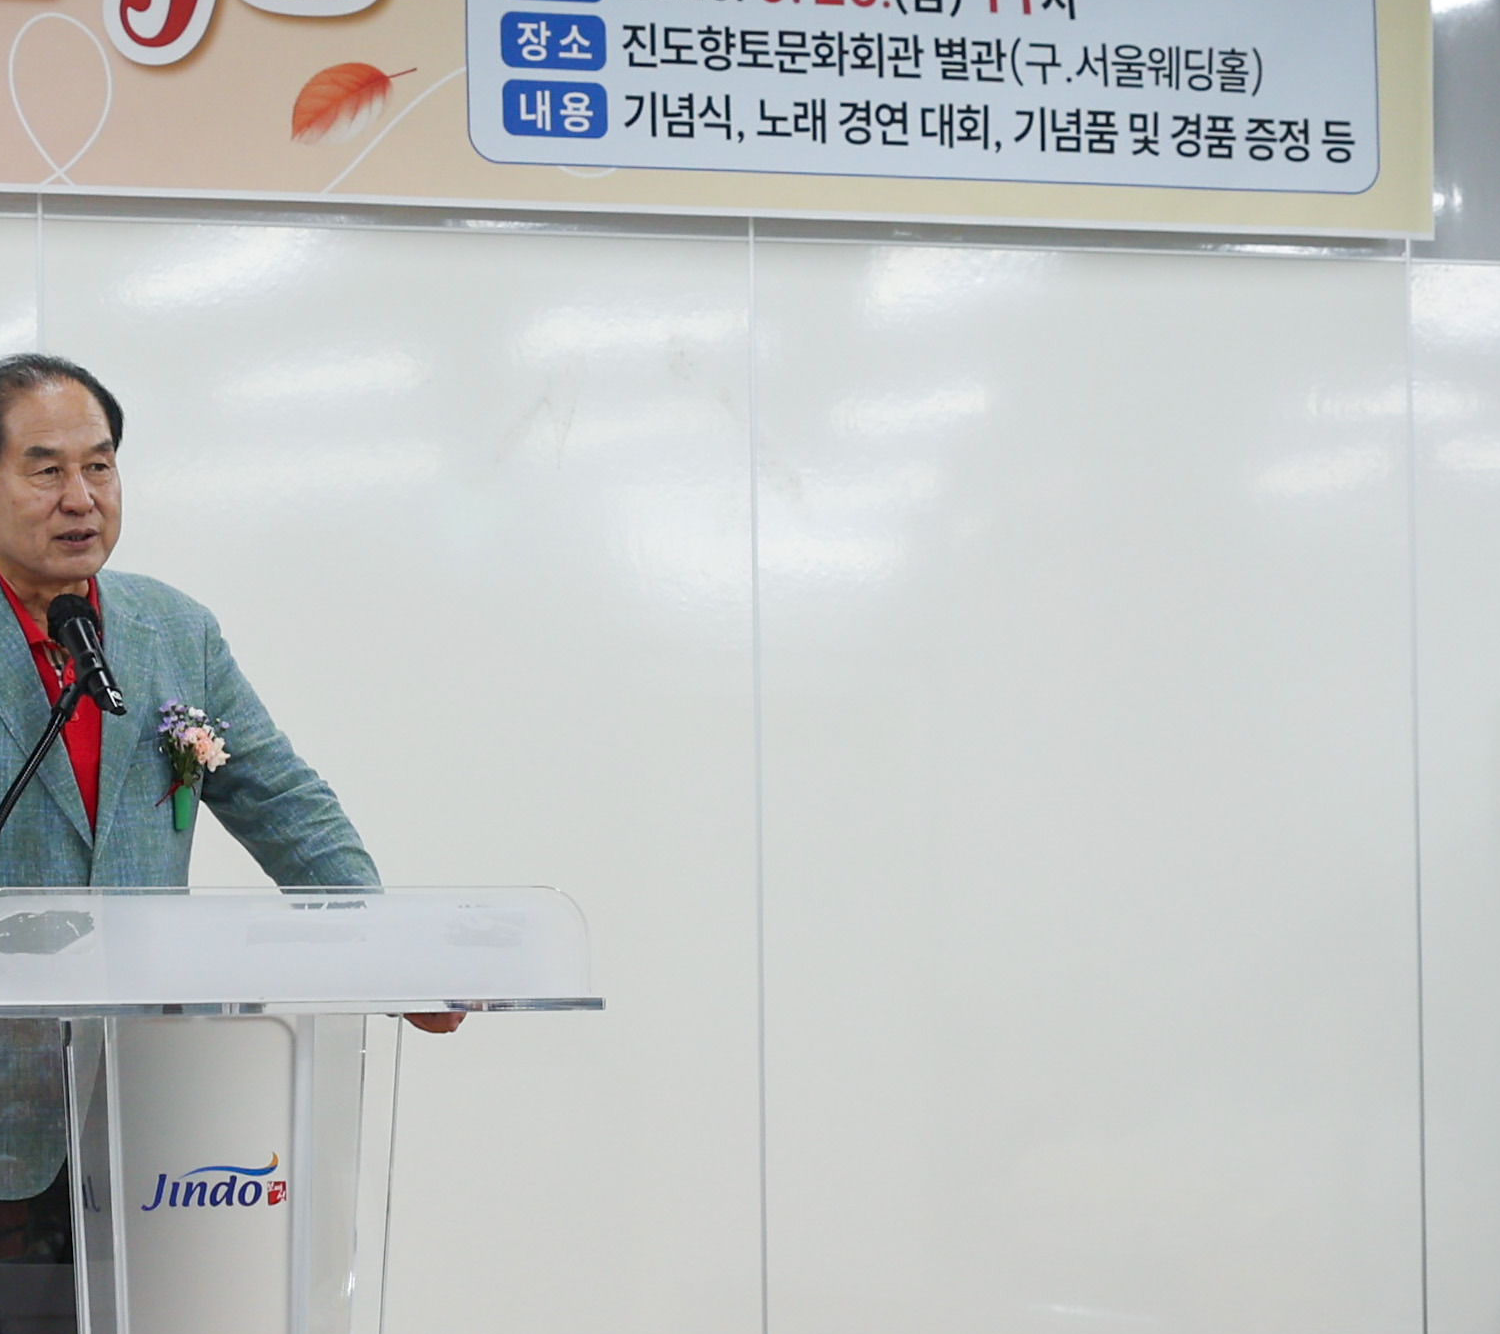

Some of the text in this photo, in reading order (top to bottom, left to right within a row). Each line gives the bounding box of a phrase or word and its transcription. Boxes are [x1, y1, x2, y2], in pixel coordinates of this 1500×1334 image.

[515, 21, 594, 63] 장소
[622, 22, 925, 79] 진도향토문화회관
[517, 90, 594, 133] 내용
[624, 91, 1357, 165] 기념식, 노래 경연 대회, 기념품 및 경품 증정 등
[141, 1173, 263, 1212] Jindo
